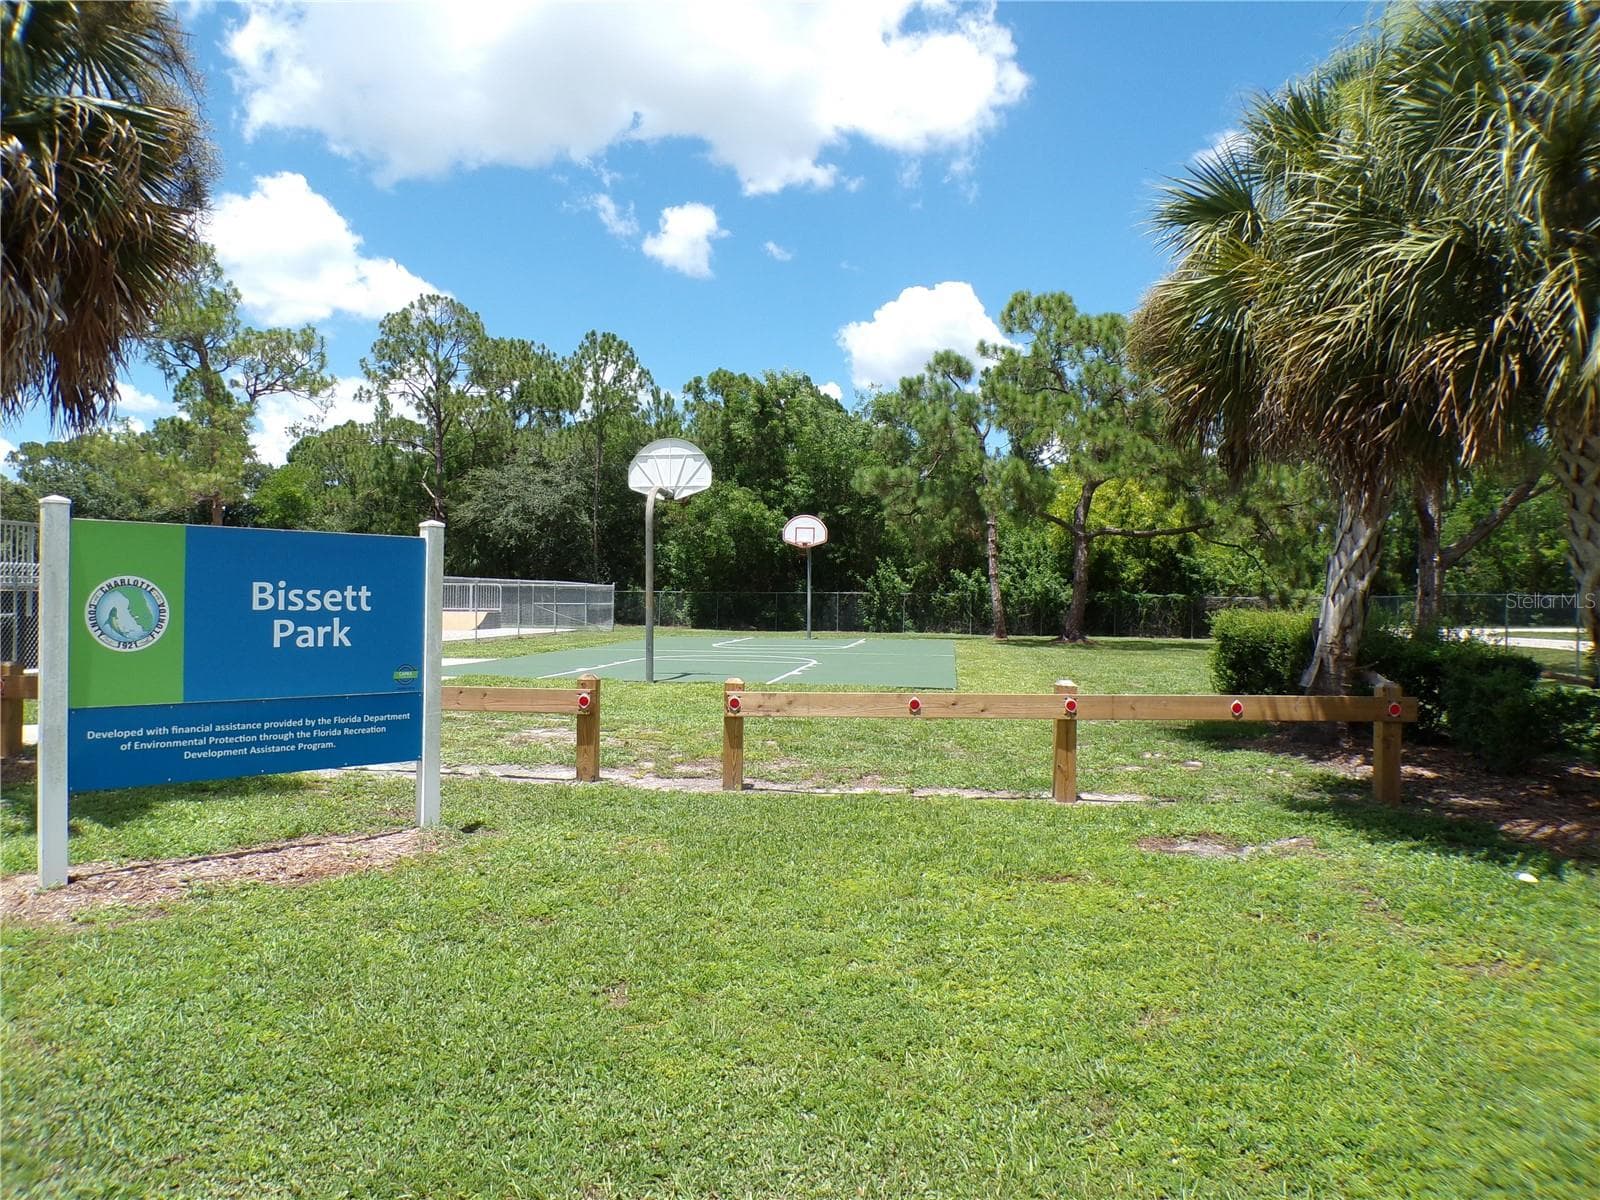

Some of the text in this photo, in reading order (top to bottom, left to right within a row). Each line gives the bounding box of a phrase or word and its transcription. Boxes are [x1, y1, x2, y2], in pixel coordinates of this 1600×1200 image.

[101, 578, 155, 594] CHARLOTTE
[252, 580, 371, 611] Bissett
[88, 604, 106, 638] COUNTY
[150, 602, 167, 640] FLORIDA
[273, 617, 352, 648] Park
[117, 640, 139, 650] 1921
[87, 712, 410, 740] Developed with financial assistance provided by the Florida Department
[120, 741, 131, 751] of
[134, 737, 207, 750] Environmental
[209, 734, 257, 745] Protection
[259, 731, 294, 744] through
[313, 727, 342, 738] Florida
[344, 725, 386, 735] Recreation
[184, 740, 336, 760] Development Assistance Program.
